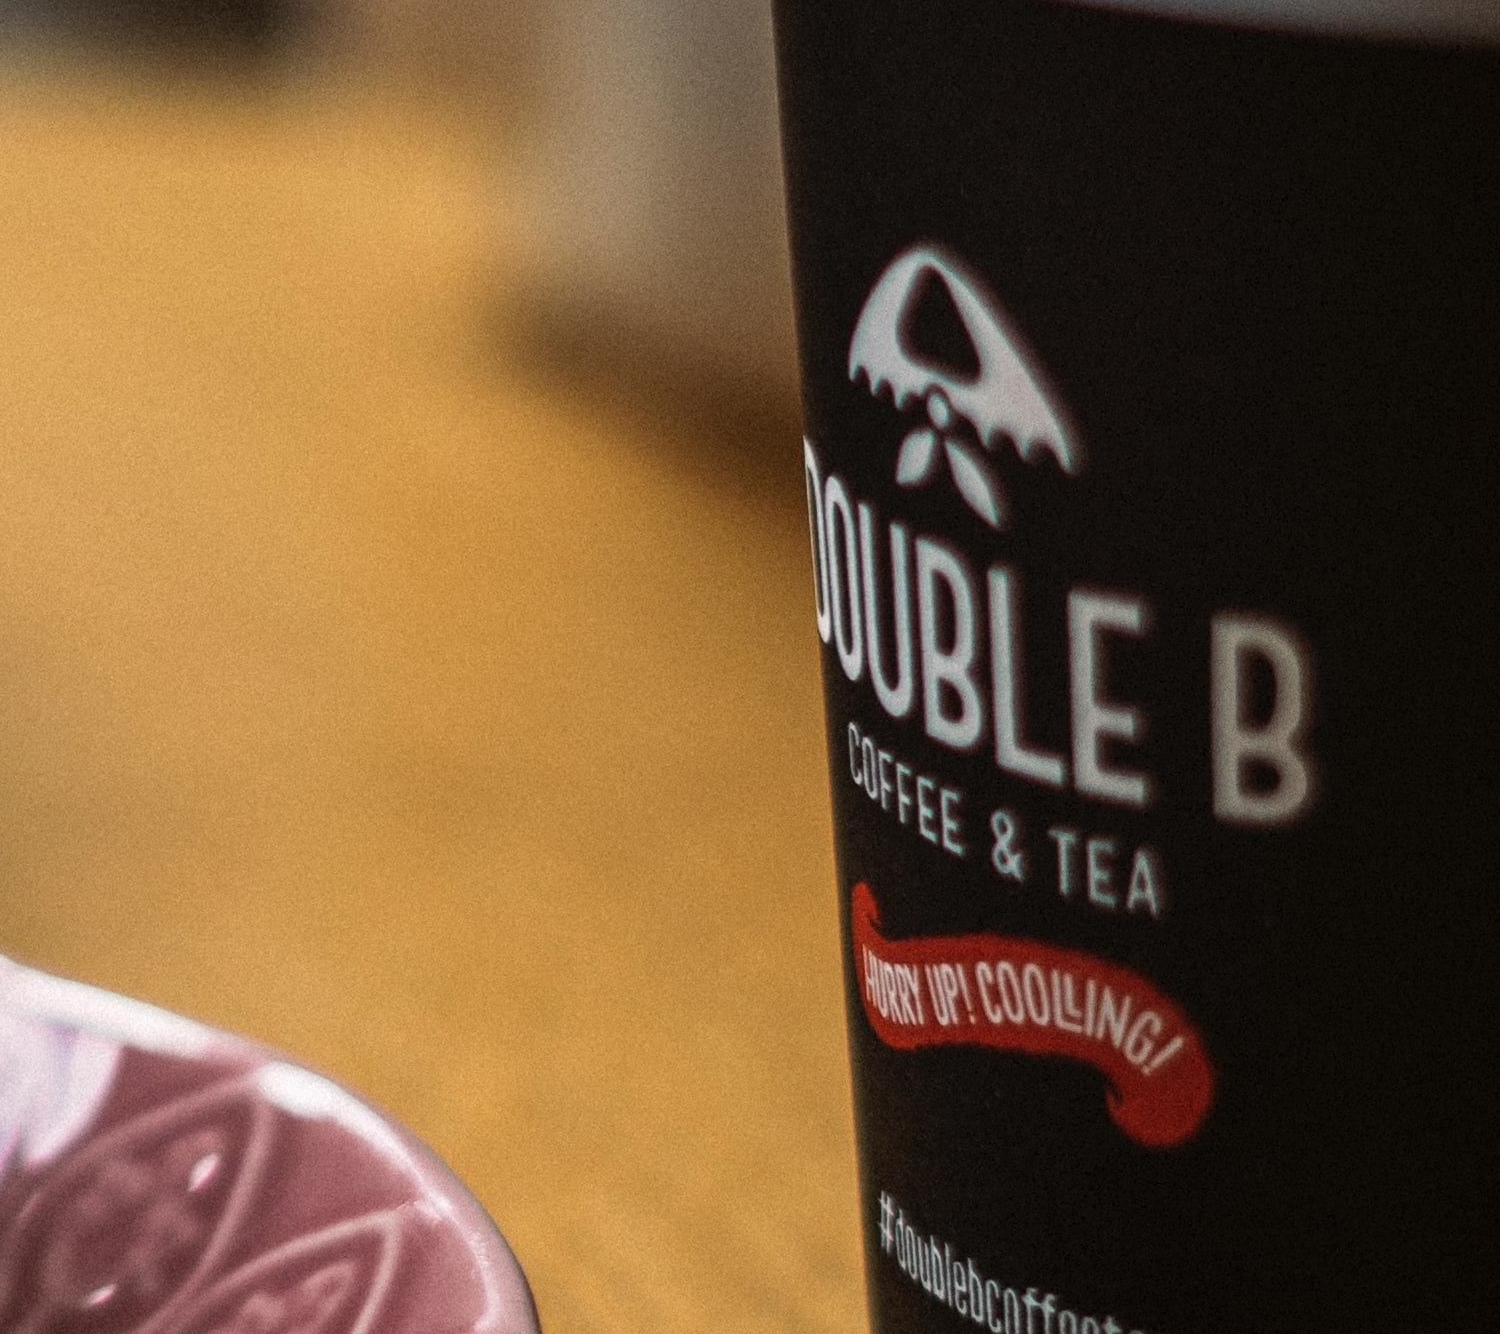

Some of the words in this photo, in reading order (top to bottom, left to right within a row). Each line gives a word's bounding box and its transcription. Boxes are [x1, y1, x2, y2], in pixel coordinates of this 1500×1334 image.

[1211, 610, 1312, 822] B
[848, 721, 965, 856] COFFEE
[991, 810, 1025, 883] &
[1050, 828, 1158, 915] TEA
[862, 943, 924, 1025] HURRY
[925, 963, 976, 1025] UP!
[976, 961, 1184, 1076] COOLLING!
